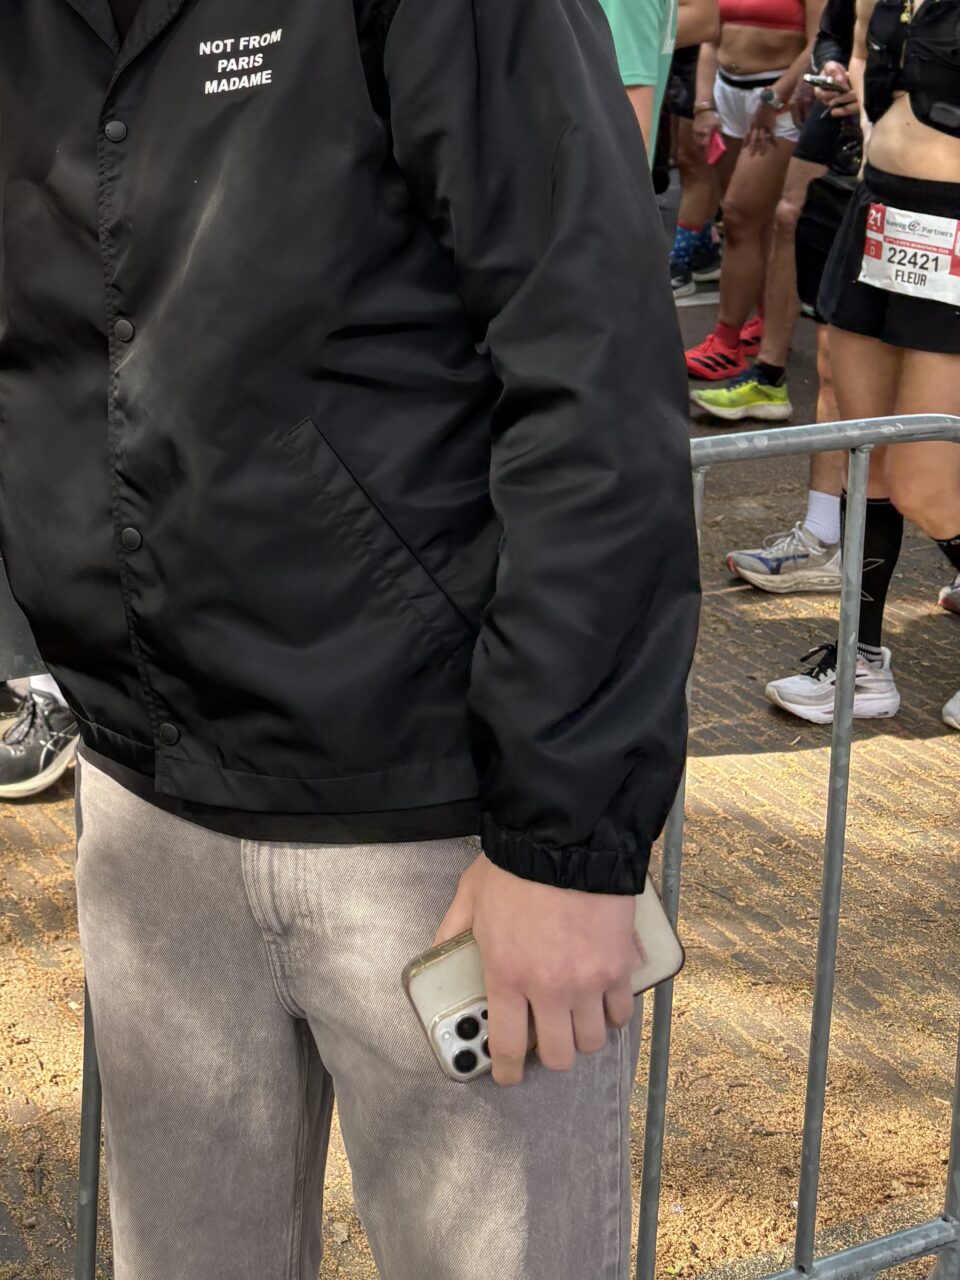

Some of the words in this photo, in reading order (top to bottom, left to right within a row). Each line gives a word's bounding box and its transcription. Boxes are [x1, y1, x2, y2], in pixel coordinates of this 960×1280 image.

[199, 38, 235, 55] NOT
[239, 28, 282, 51] FROM
[217, 53, 264, 73] PARIS
[204, 69, 273, 95] MADAME
[869, 209, 881, 226] 21
[922, 227, 953, 237] Partners
[887, 247, 940, 272] 22421
[895, 270, 927, 286] FLEUR
